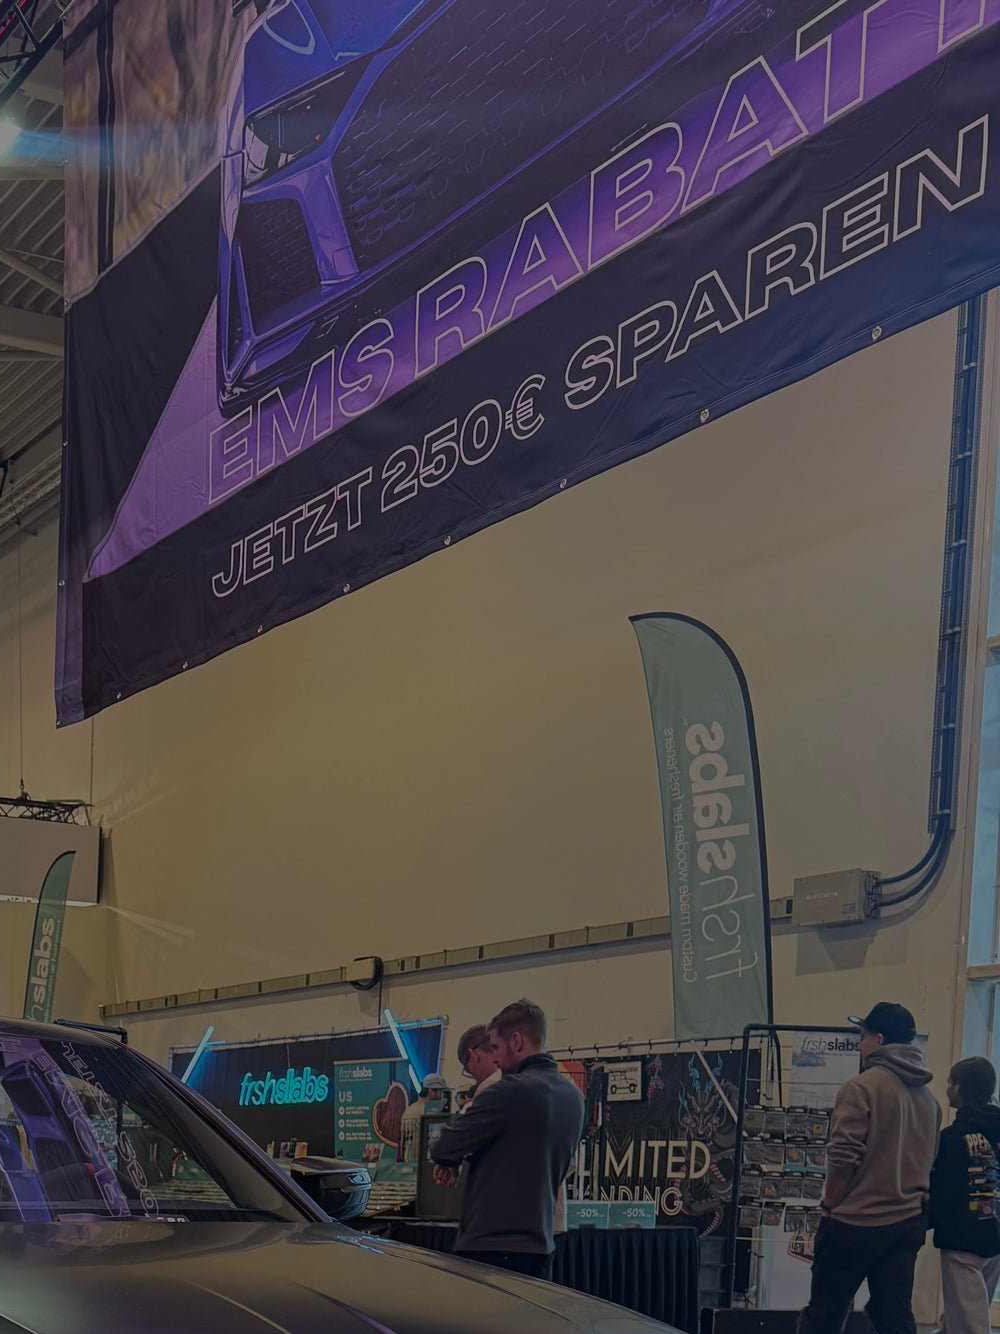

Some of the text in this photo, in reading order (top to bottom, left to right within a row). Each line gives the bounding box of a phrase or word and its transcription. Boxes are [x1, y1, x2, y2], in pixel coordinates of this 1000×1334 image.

[211, 114, 989, 598] JETZT 250€ SPAREN
[209, 317, 395, 505] EMS
[239, 1066, 329, 1106] frshslabs
[338, 1091, 353, 1104] US
[576, 1208, 599, 1219] -50%
[622, 1208, 646, 1219] -50%
